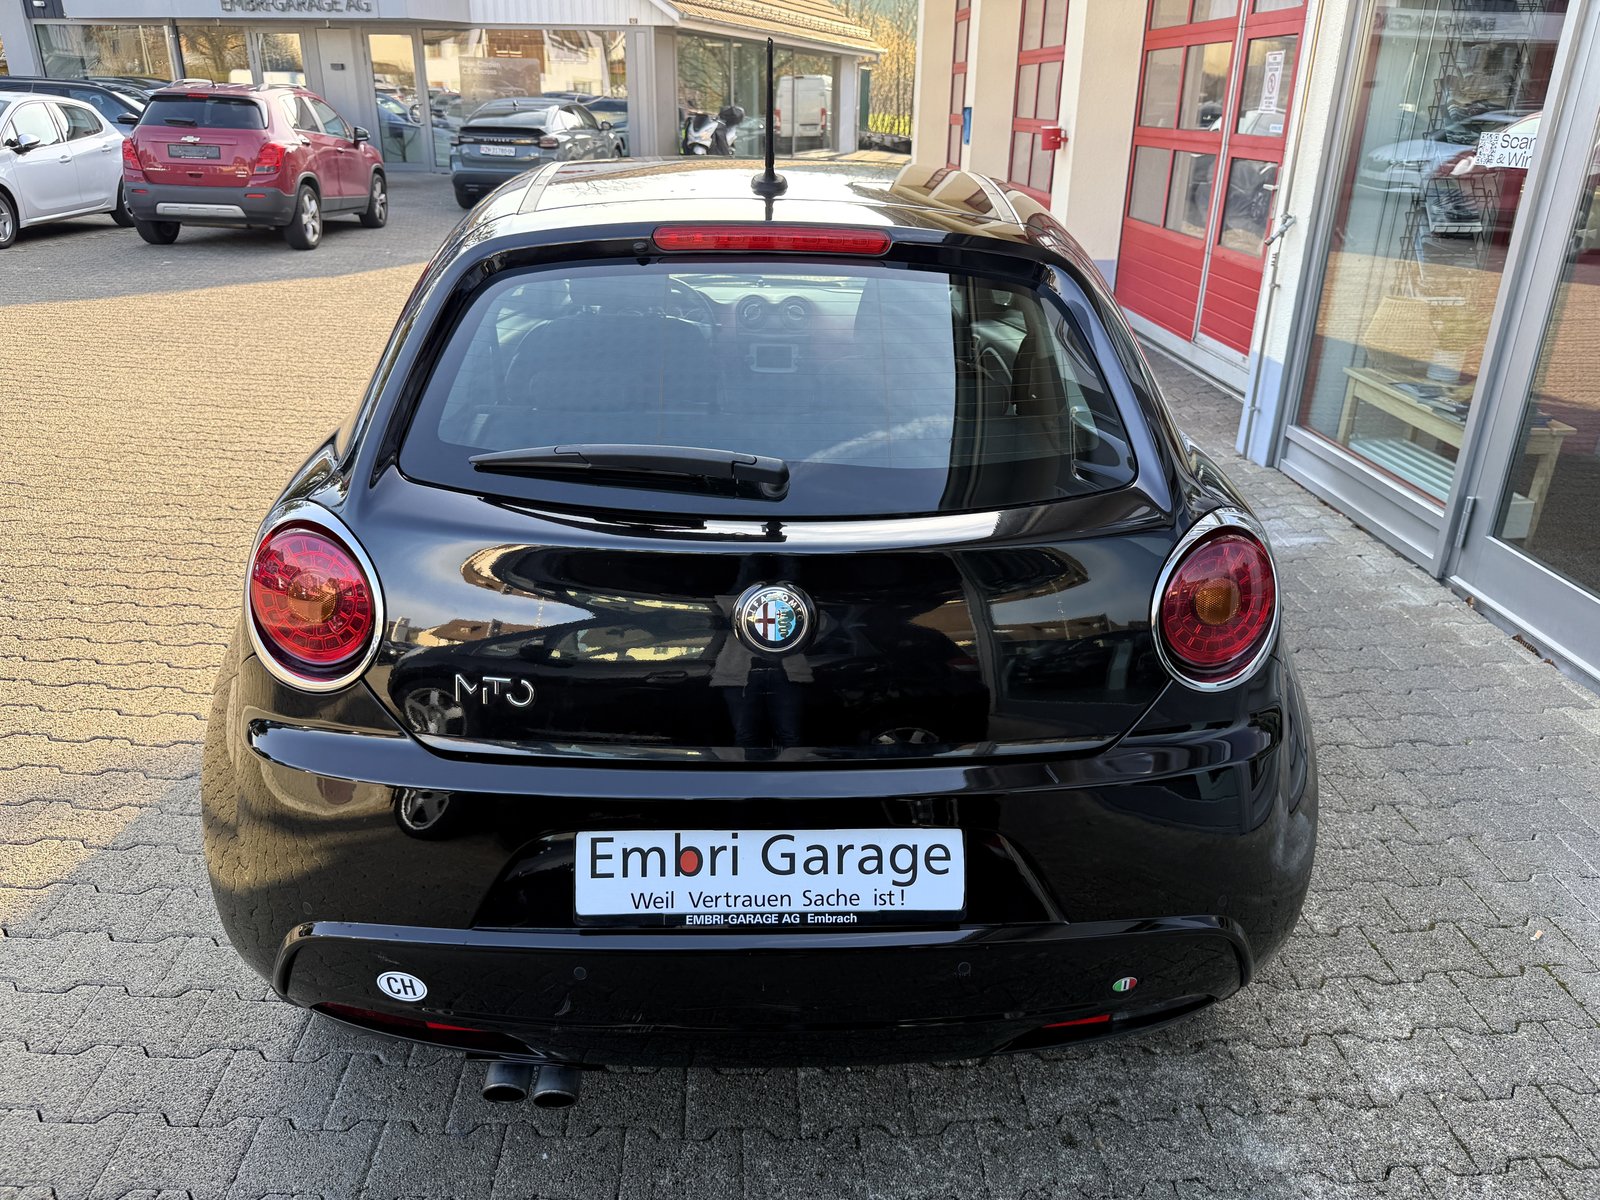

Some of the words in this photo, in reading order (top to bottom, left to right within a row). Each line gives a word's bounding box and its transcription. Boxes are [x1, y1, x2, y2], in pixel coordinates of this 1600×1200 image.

[345, 0, 372, 12] AG
[1496, 153, 1505, 164] &
[747, 595, 768, 622] ALFA
[590, 832, 738, 879] Embri
[761, 833, 952, 887] Garage
[630, 890, 675, 910] Weil
[688, 890, 792, 909] Vertrauen
[802, 888, 860, 907] Sache
[685, 914, 779, 925] EMBRI-GARAGE
[781, 914, 800, 924] AG
[807, 913, 858, 924] Embrach
[386, 976, 417, 996] CH
